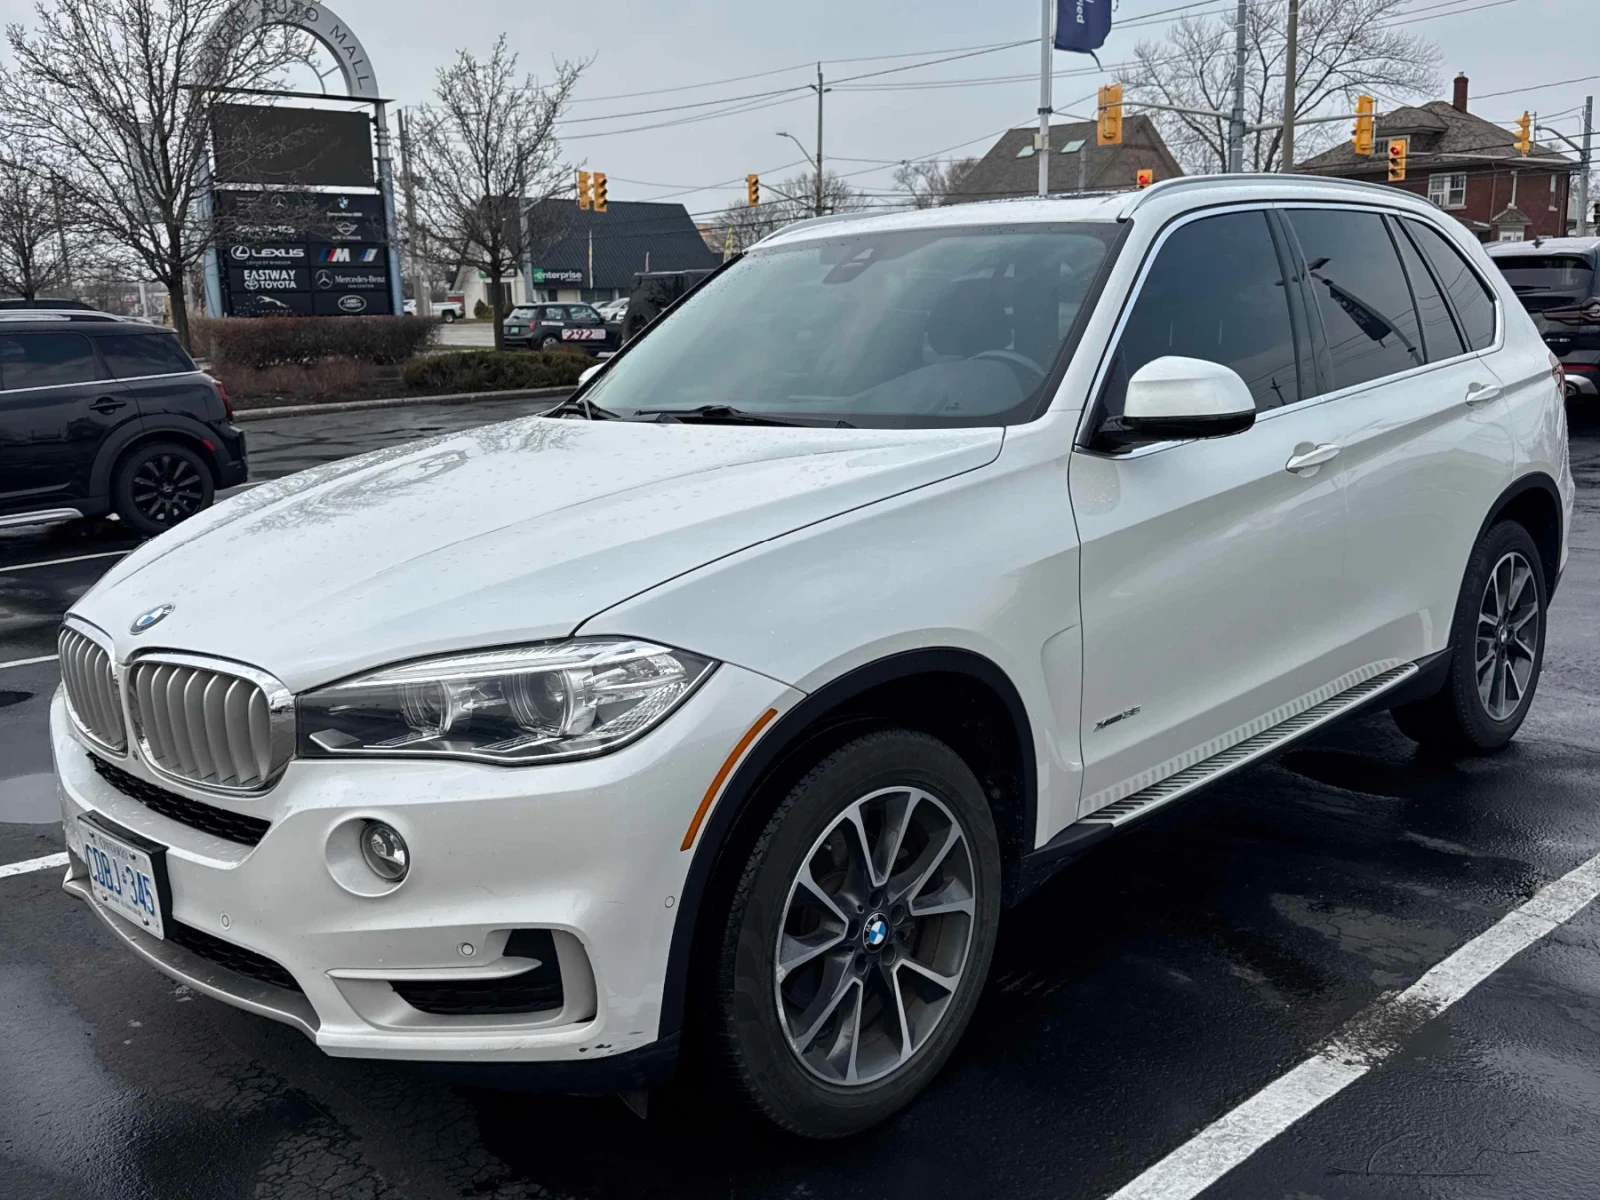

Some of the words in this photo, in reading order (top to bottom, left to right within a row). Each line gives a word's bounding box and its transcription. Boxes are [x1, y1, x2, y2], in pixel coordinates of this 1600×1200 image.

[329, 24, 370, 90] MALL
[251, 248, 305, 258] LEXUS
[243, 269, 296, 280] EASTWAY
[334, 274, 386, 283] Mercedes-Benz
[536, 270, 582, 281] enterprise
[259, 280, 297, 289] TOYOTA
[566, 329, 594, 339] 292
[85, 843, 122, 896] CDBJ
[125, 865, 155, 916] 345
